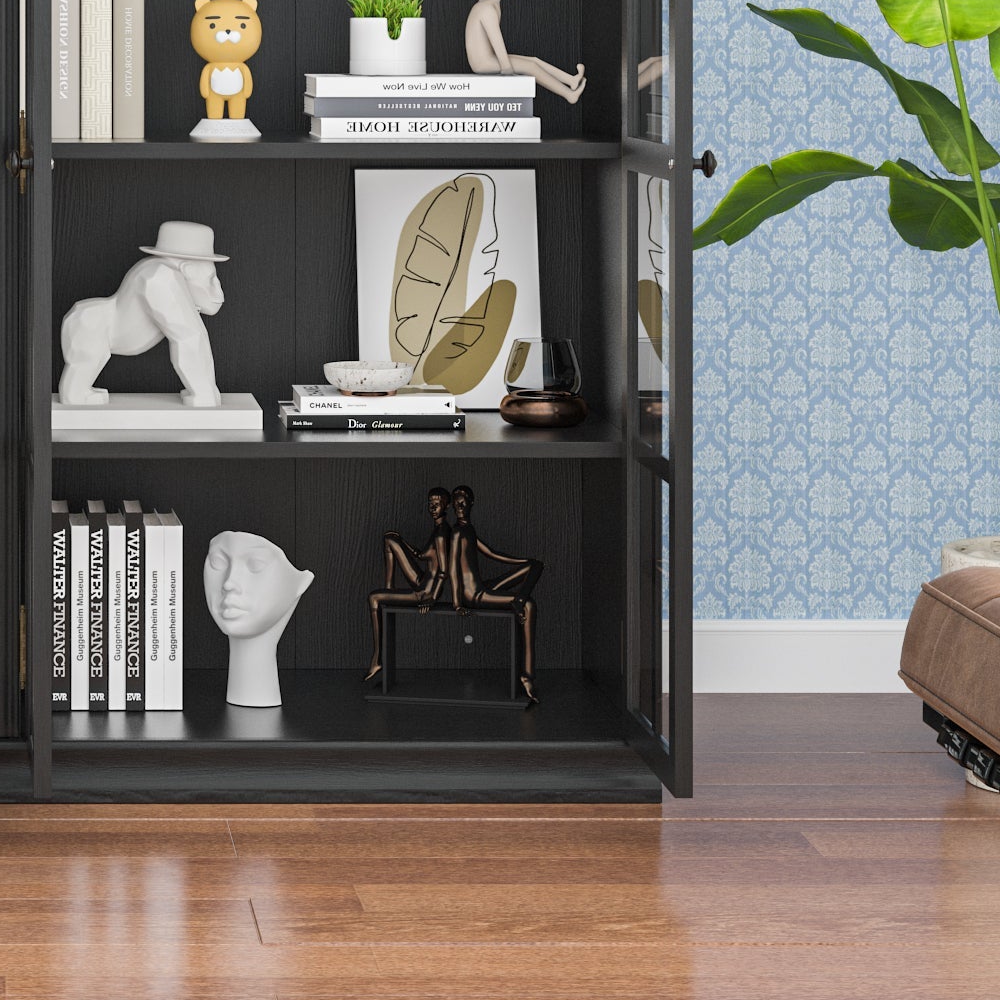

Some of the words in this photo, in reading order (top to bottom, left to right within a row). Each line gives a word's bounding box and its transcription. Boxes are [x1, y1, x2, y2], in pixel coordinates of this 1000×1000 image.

[348, 419, 367, 428] Dior
[372, 420, 403, 428] Glamour
[53, 528, 66, 599] WALTER
[90, 528, 103, 599] WALTER
[127, 528, 140, 599] WALTER
[53, 601, 66, 678] FINANCE
[90, 601, 103, 678] FINANCE
[127, 601, 140, 678] FINANCE
[52, 693, 67, 701] EVR
[90, 693, 105, 701] EVR
[126, 693, 142, 701] EVR
